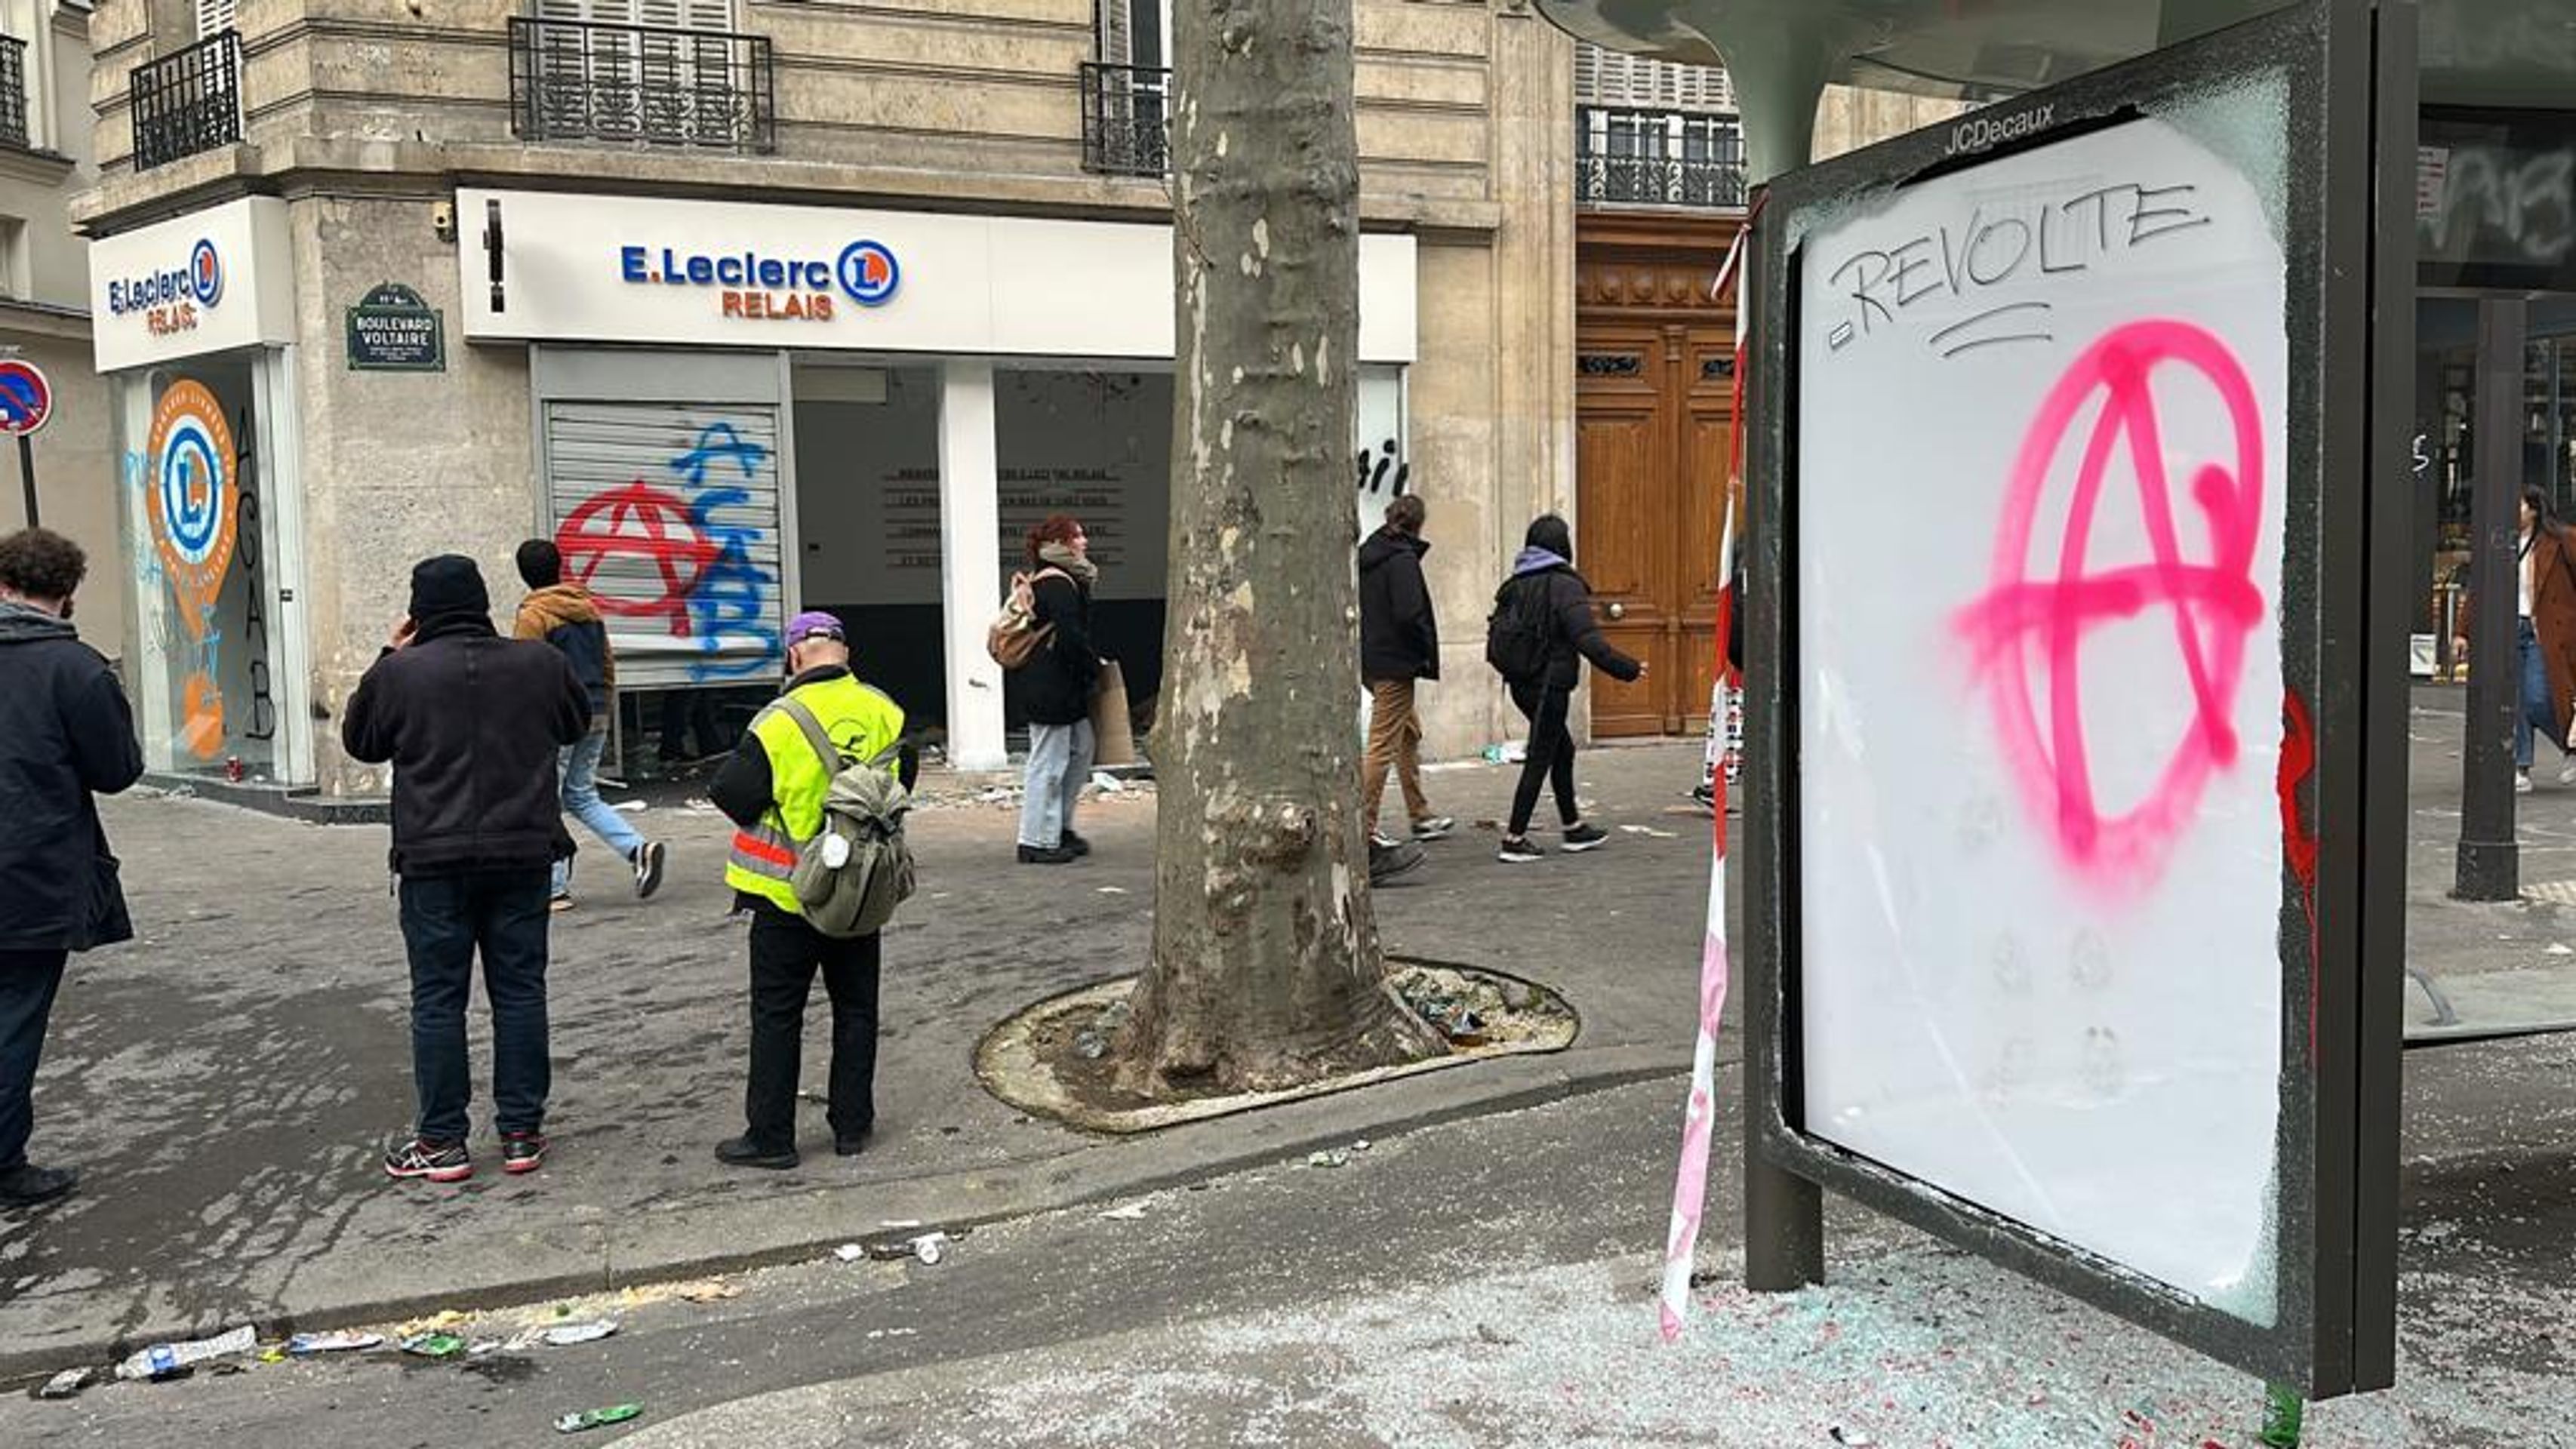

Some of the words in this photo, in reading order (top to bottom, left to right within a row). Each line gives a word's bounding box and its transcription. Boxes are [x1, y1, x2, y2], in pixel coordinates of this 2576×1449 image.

[1945, 103, 2054, 155] JCDecaux
[620, 245, 830, 291] E.Leclerc
[1829, 183, 2211, 334] REVOLTE
[357, 317, 433, 331] BOULEVARD
[722, 291, 835, 321] RELAIS
[362, 332, 428, 346] VOLTAIRE
